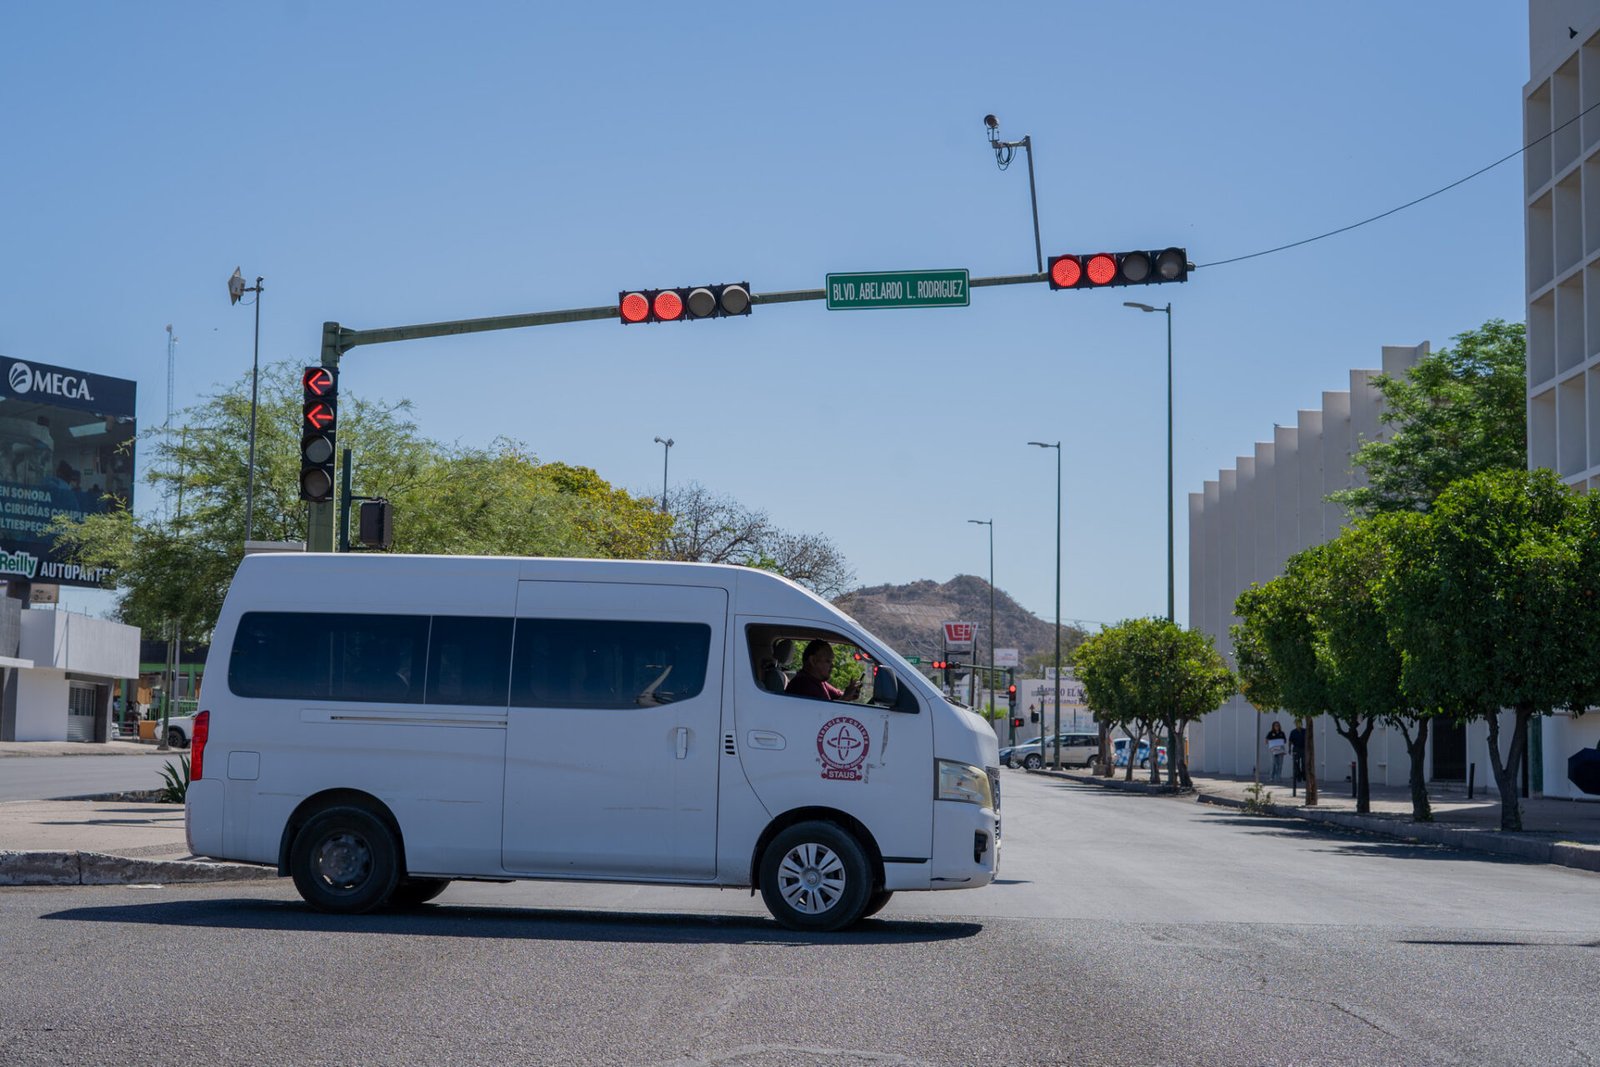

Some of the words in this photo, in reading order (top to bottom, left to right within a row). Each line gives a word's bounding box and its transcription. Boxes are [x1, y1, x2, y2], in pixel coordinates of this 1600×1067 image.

[832, 283, 859, 301] BLVD.
[859, 281, 903, 300] ABELARDO
[906, 281, 917, 299] L.
[917, 279, 964, 298] RODRIGUEZ
[11, 487, 52, 503] SONORA
[4, 502, 50, 518] CIRUGÍAS
[828, 770, 855, 779] STAUS
